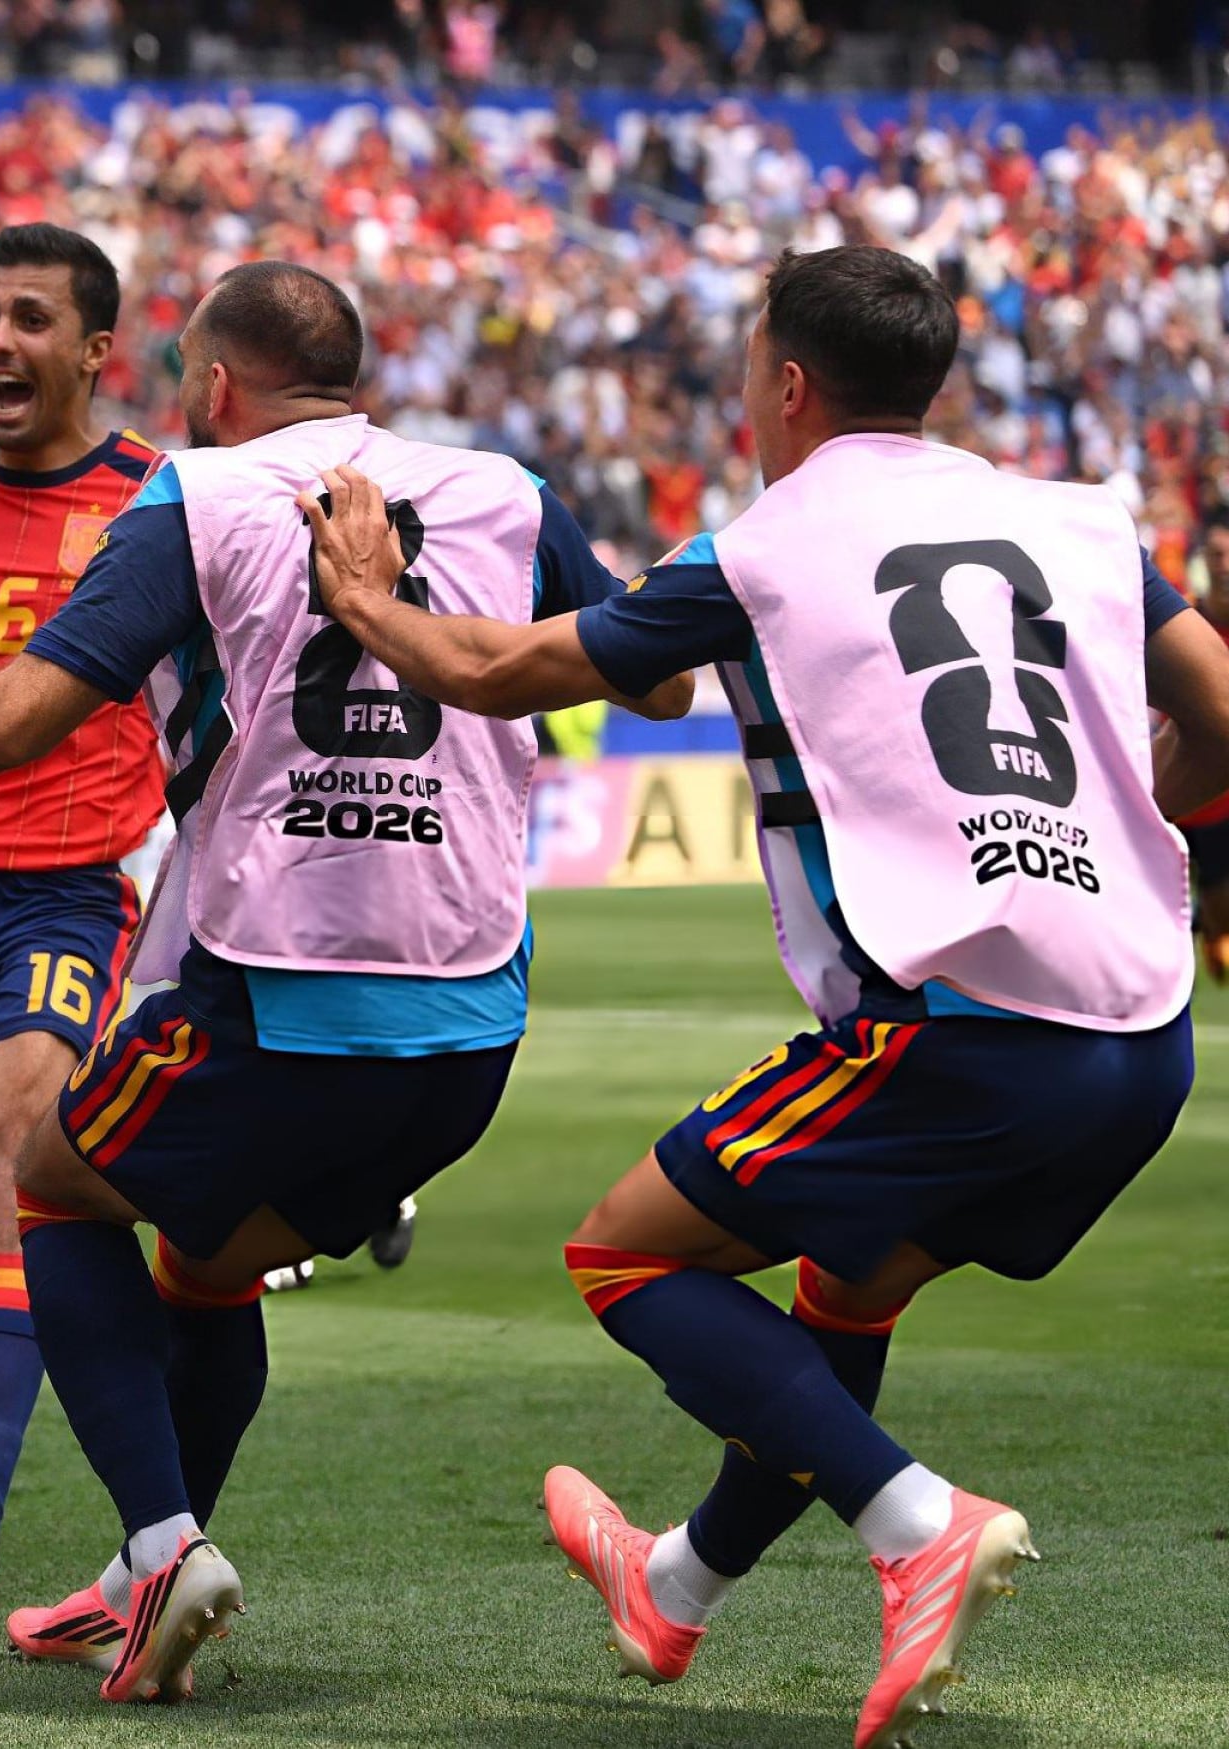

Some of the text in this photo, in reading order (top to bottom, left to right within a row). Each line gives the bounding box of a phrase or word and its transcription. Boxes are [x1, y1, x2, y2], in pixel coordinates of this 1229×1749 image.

[344, 704, 408, 734] FIFA
[990, 743, 1052, 782] FIFA
[288, 770, 442, 801] WORLD CUP
[282, 799, 443, 845] 2026
[970, 840, 1100, 894] 2026
[27, 952, 94, 1026] 16
